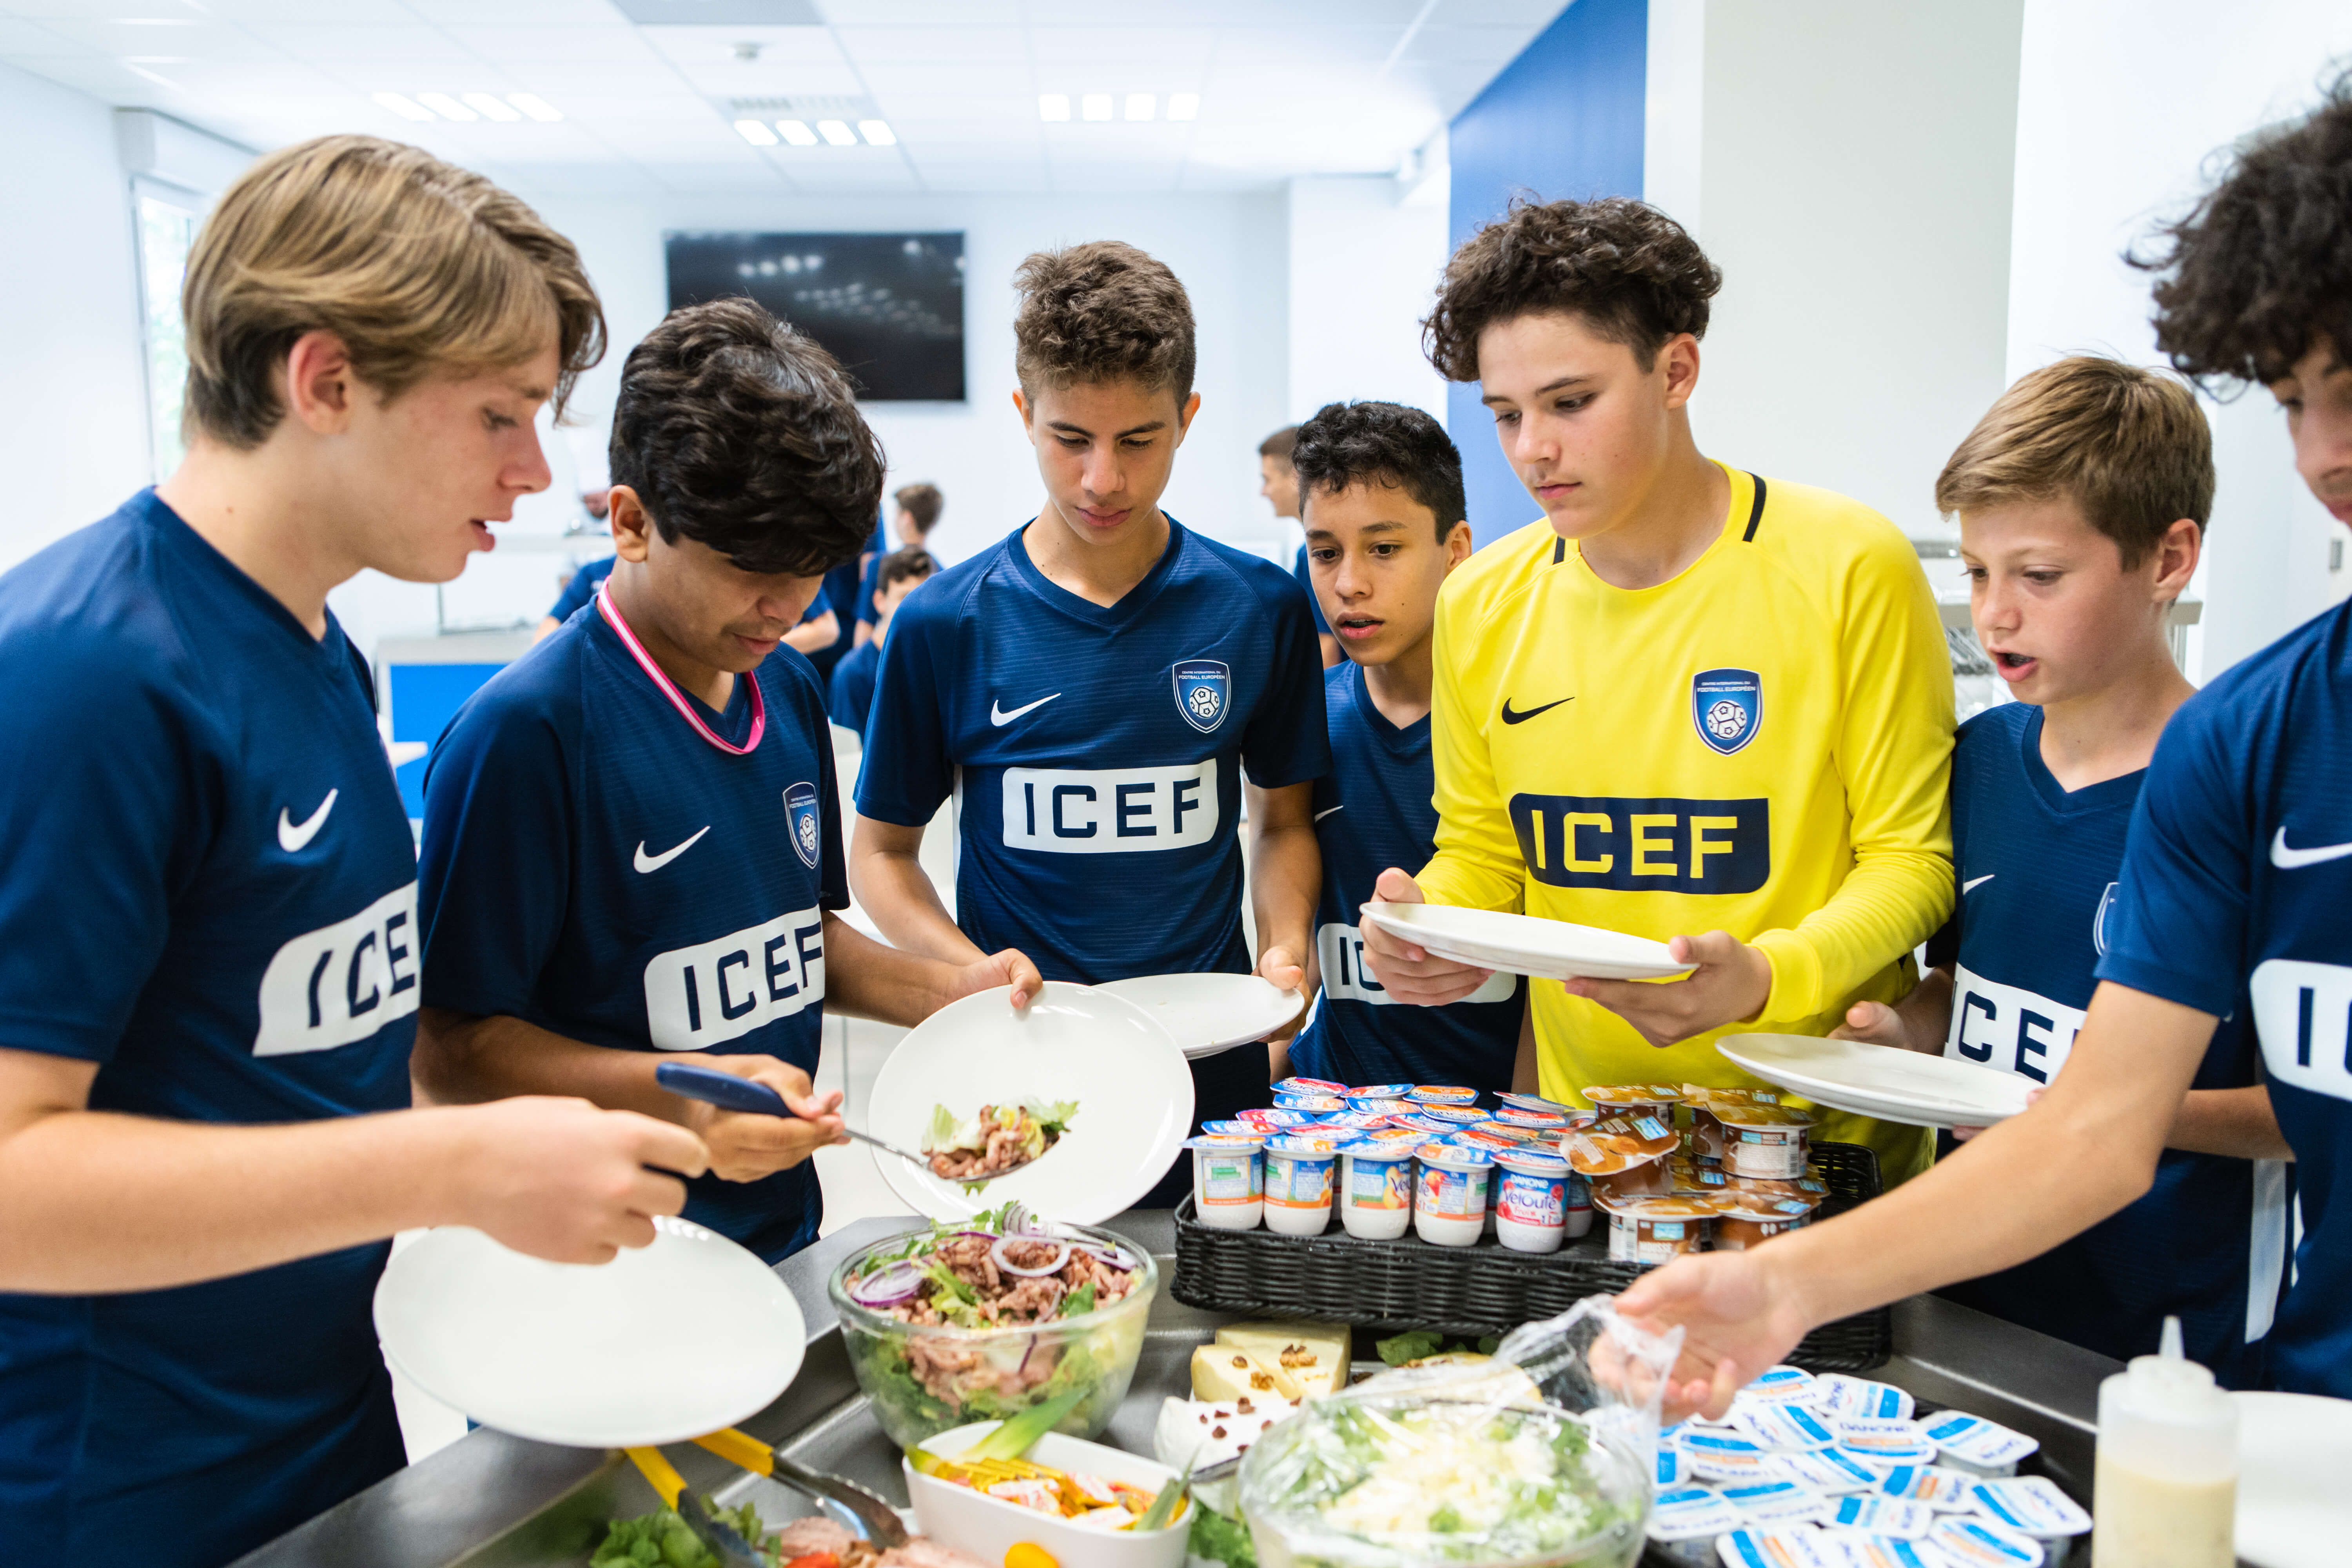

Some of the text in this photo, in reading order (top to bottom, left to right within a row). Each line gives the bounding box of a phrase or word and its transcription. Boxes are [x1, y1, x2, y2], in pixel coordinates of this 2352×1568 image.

[1024, 777, 1201, 838] ICEF
[1531, 809, 1738, 878] ICEF
[309, 910, 416, 1029] ICE
[683, 921, 823, 1032] ICEF
[1947, 981, 2080, 1085] CE
[1504, 1189, 1556, 1209] Velouté
